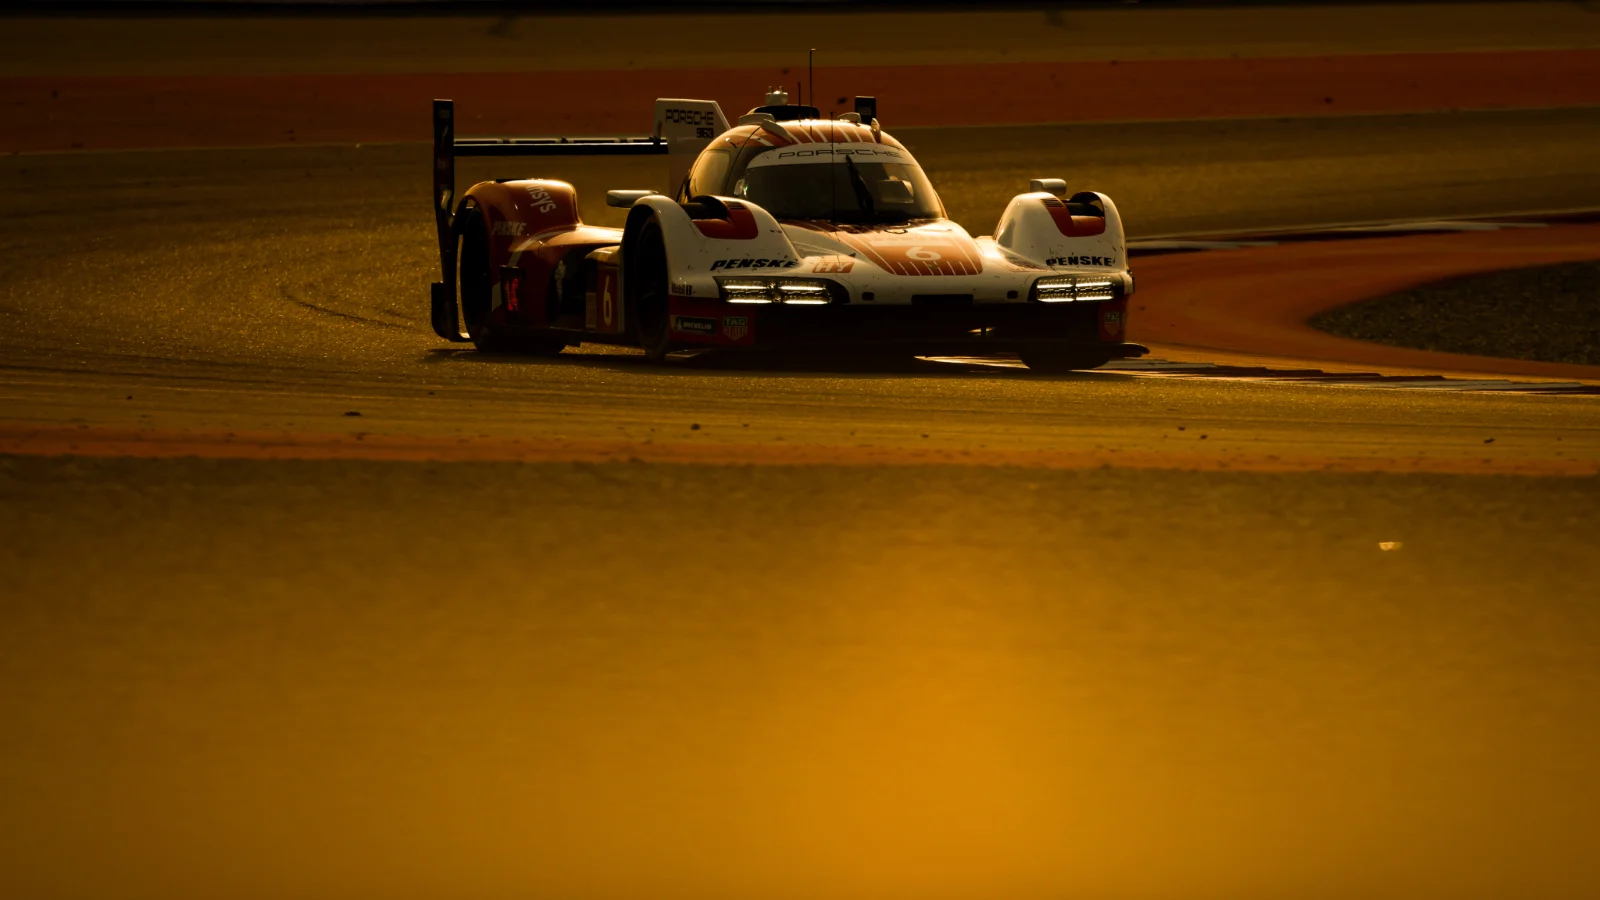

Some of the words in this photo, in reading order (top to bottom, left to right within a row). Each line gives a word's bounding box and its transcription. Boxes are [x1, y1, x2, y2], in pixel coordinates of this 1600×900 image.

[665, 109, 714, 126] PORSCHE
[778, 148, 903, 160] PORSCHE
[905, 246, 942, 261] 6
[709, 258, 797, 272] PENSKE
[1045, 256, 1114, 267] PENSKE
[602, 274, 613, 328] 6
[682, 321, 713, 331] MICHELIN
[724, 318, 746, 326] TAG
